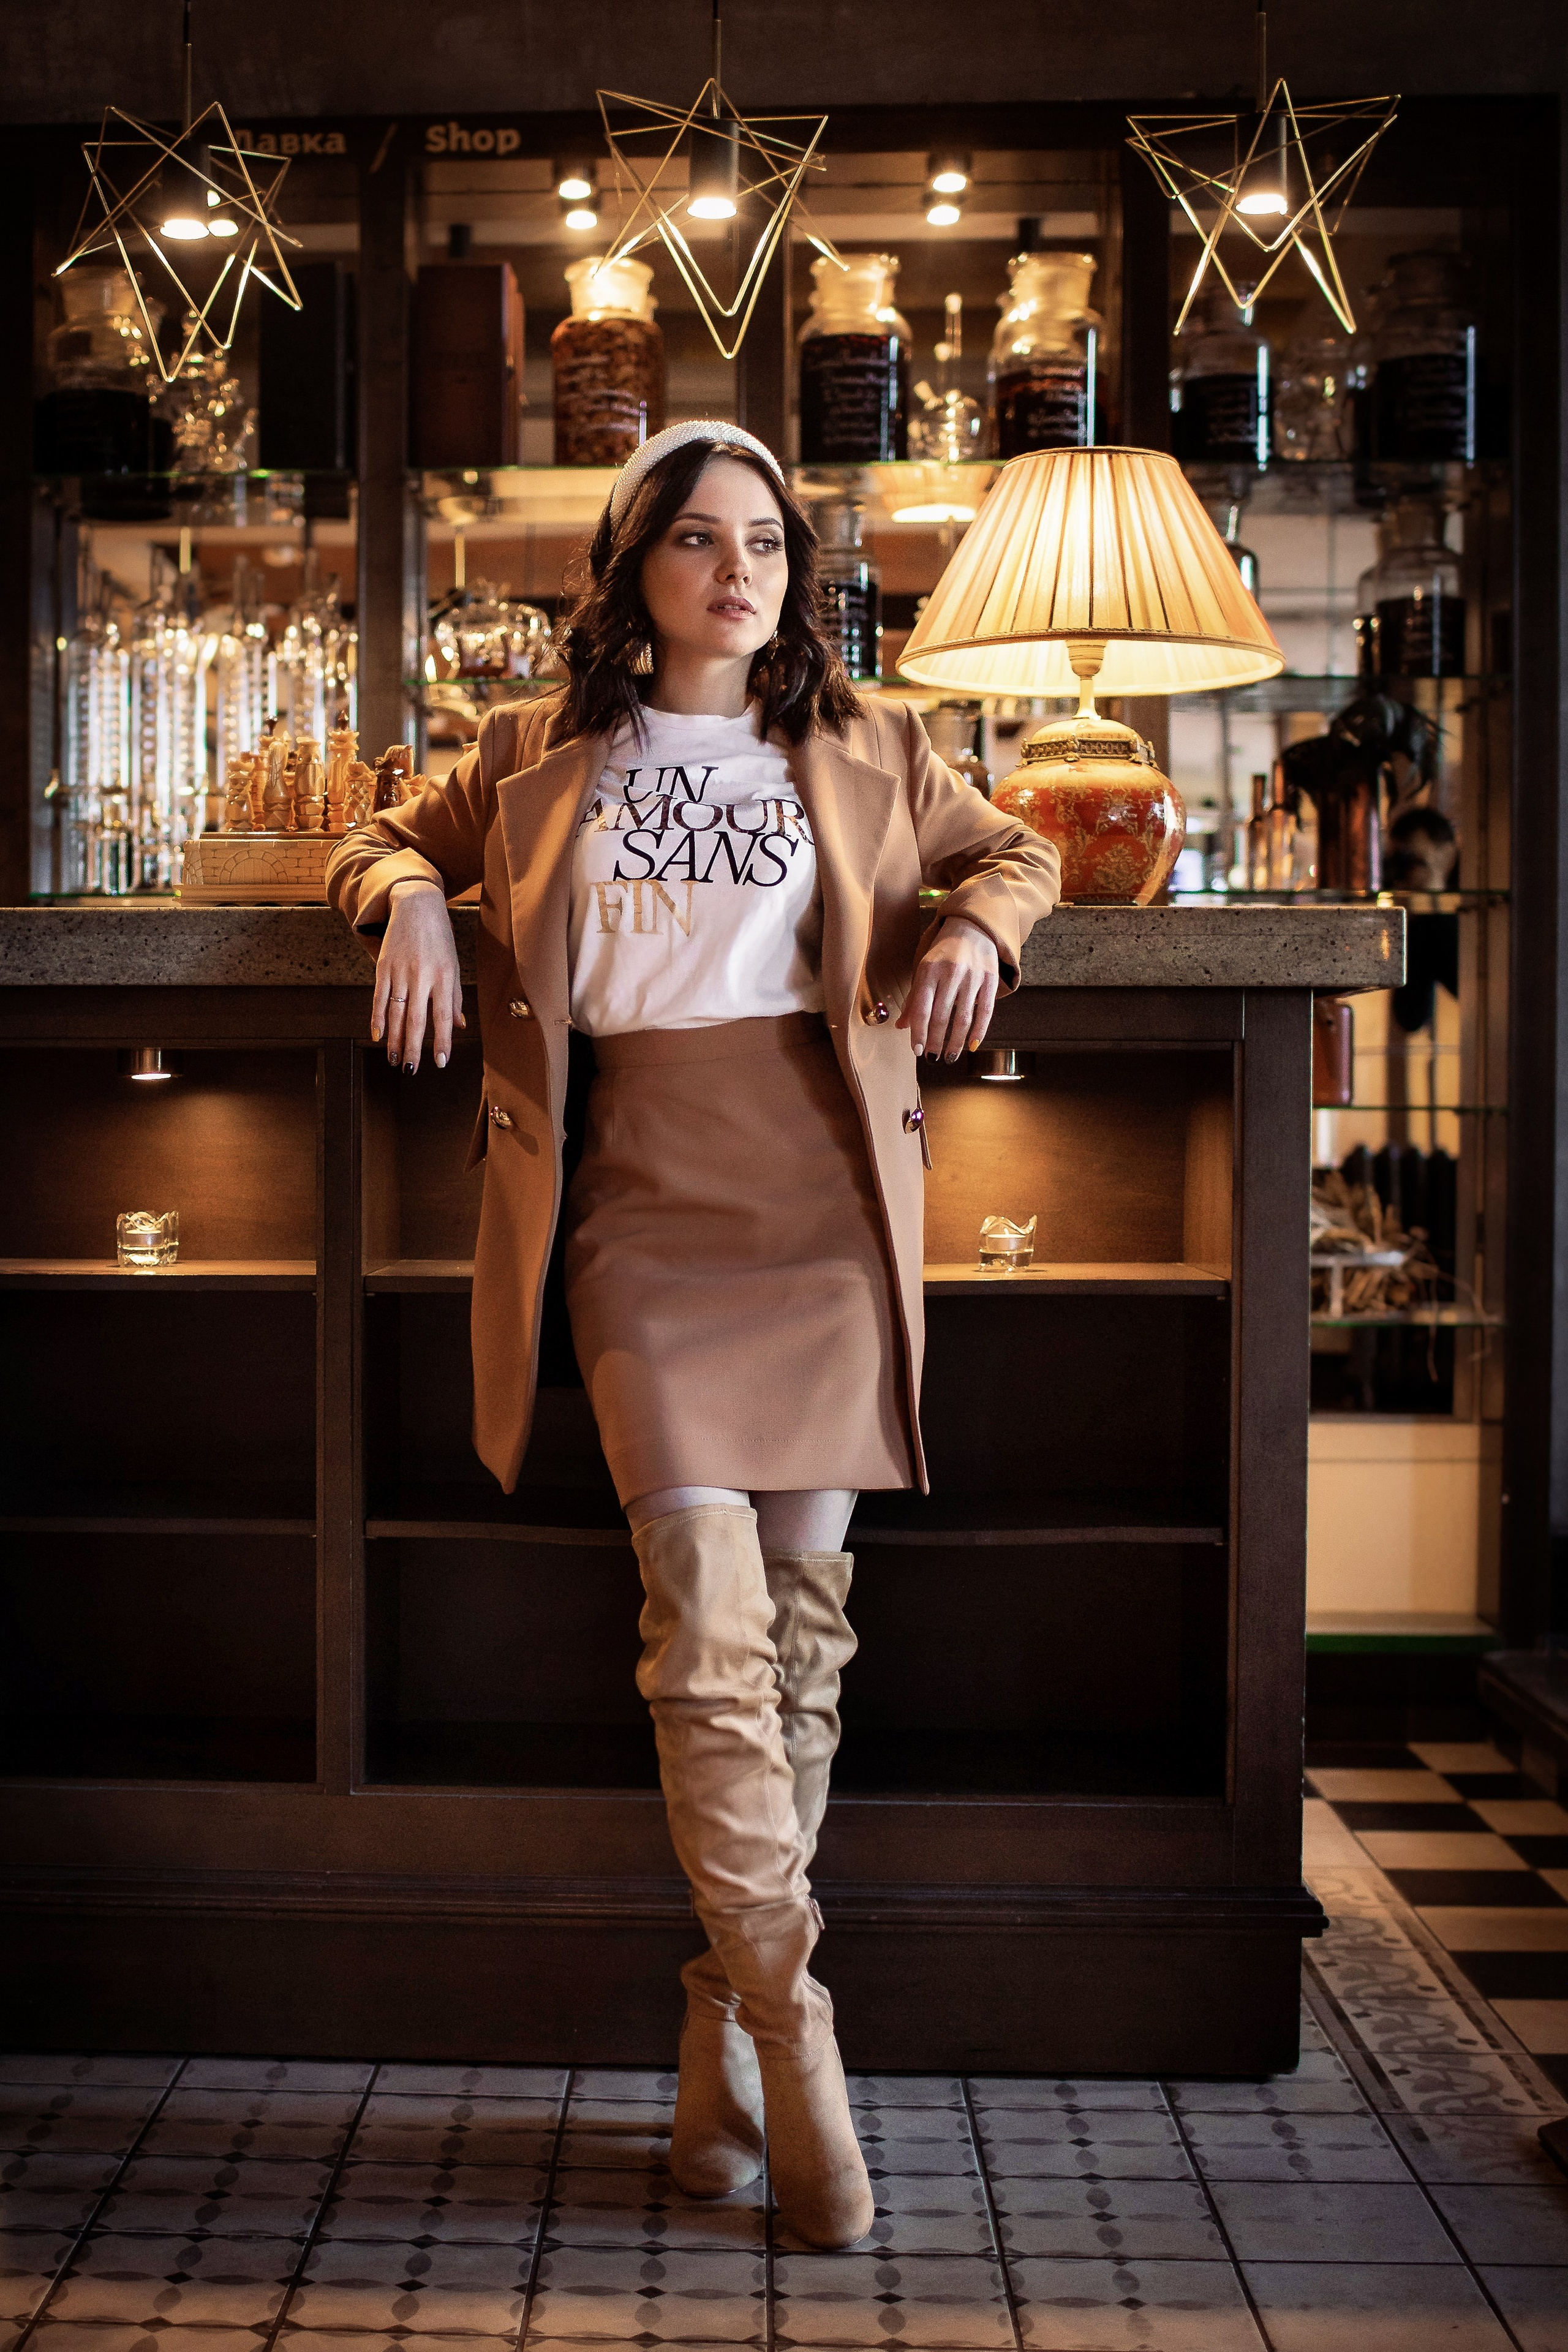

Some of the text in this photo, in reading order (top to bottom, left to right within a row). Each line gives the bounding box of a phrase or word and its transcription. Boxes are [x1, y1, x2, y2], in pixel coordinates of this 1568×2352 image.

[426, 122, 521, 156] Shop
[624, 766, 718, 803] UN
[576, 793, 815, 846] AMOUR
[612, 829, 799, 887] SANS
[590, 880, 698, 937] FIN
